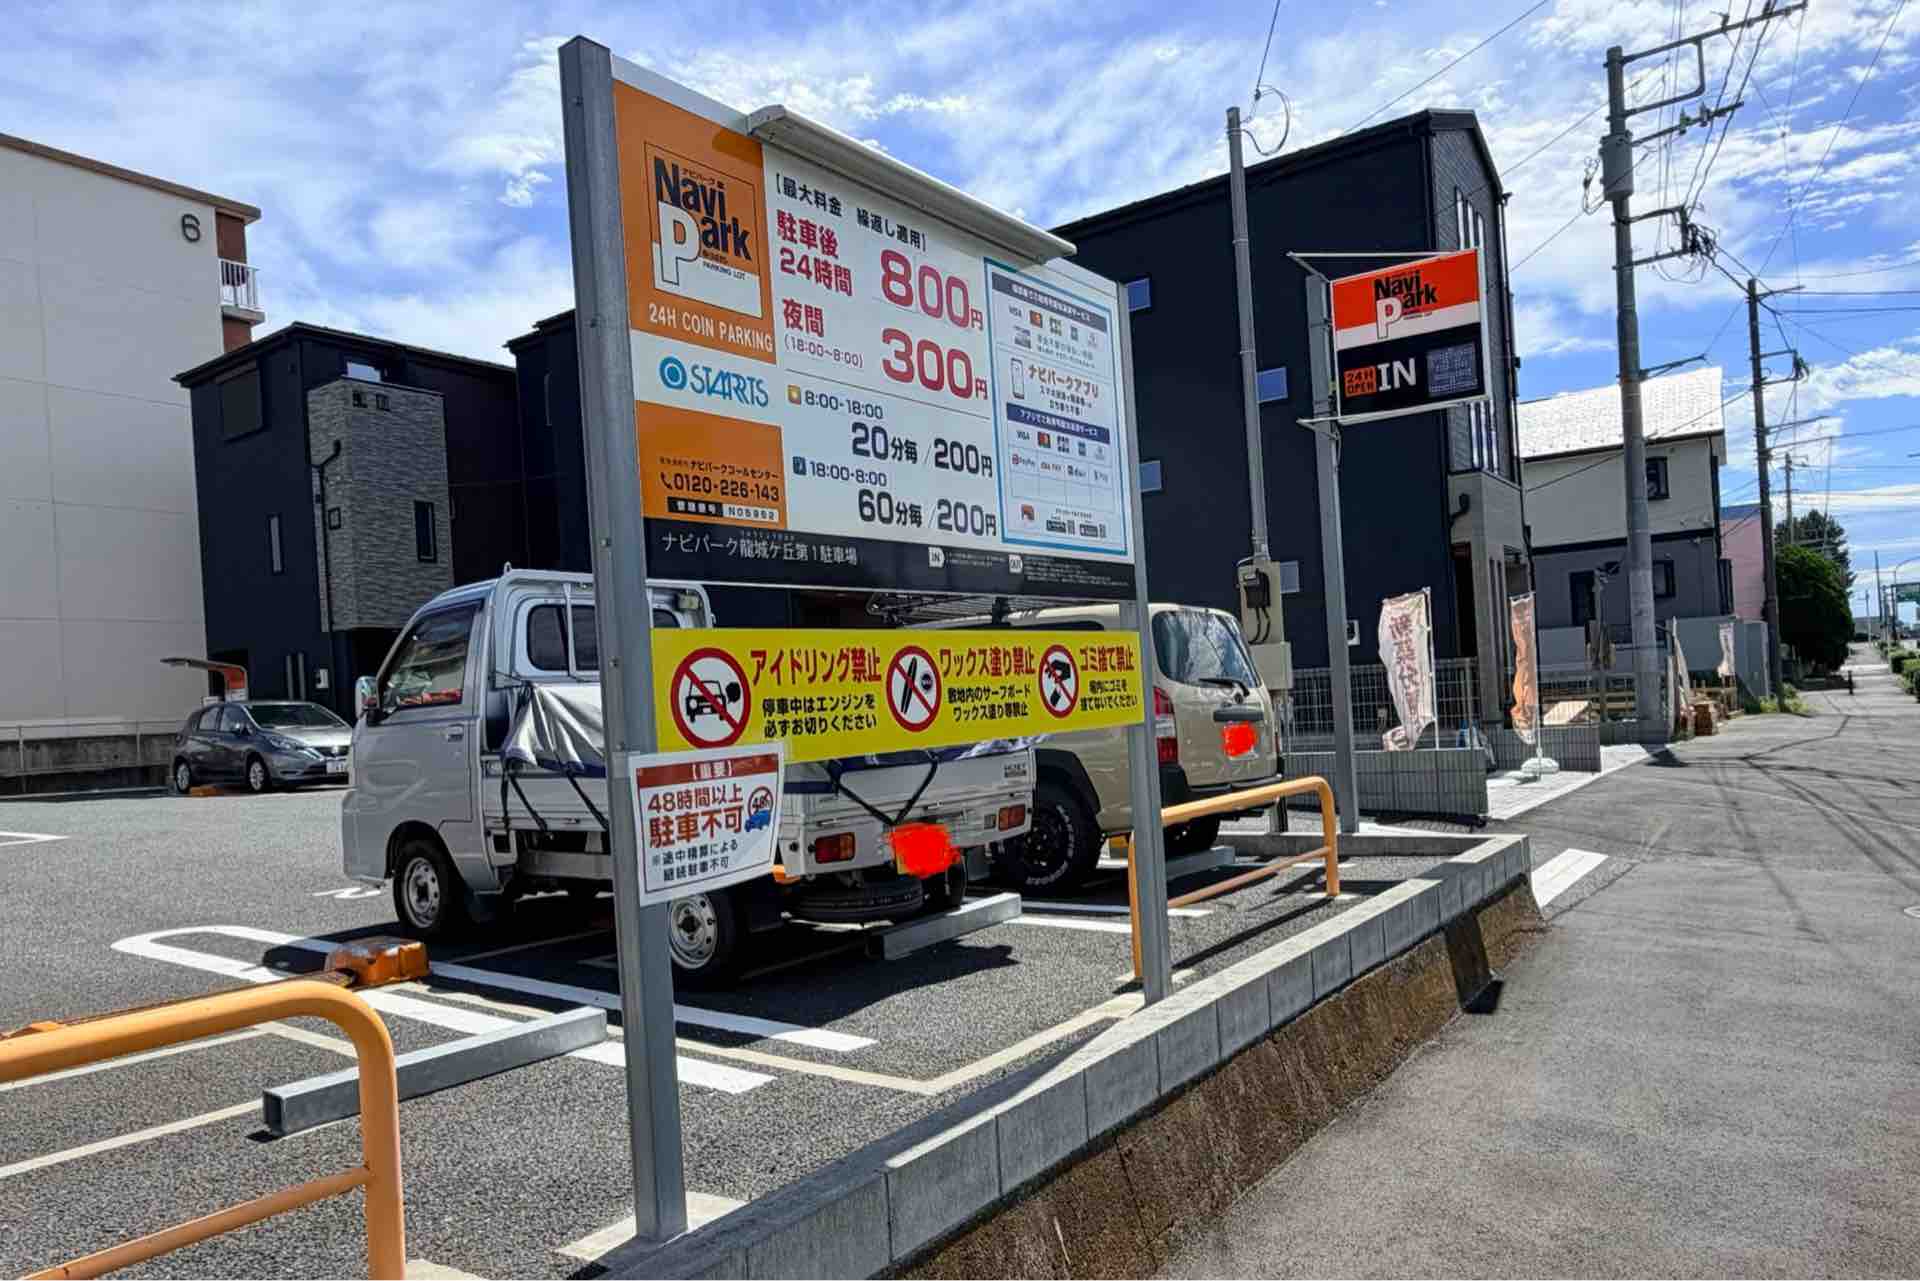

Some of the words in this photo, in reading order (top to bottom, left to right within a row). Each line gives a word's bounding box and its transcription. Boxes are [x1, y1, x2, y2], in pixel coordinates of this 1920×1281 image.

[654, 156, 726, 220] Navi
[181, 213, 201, 242] 6
[658, 200, 752, 286] Park
[776, 209, 839, 259] 駐車後
[780, 247, 852, 296] 24時間
[880, 249, 984, 331] 800円
[1374, 270, 1421, 301] Navi
[649, 302, 677, 328] 24H
[681, 311, 715, 337] COIN
[719, 321, 773, 353] PARKING
[782, 298, 824, 338] 夜間
[1376, 284, 1438, 340] Park
[882, 328, 988, 400] 300円
[1377, 357, 1416, 392] IN
[690, 364, 769, 407] STARTS
[750, 646, 882, 686] アイドリング禁止
[939, 645, 1037, 678] ワックス塗り禁止
[1079, 645, 1135, 673] ゴミ捨て禁止
[762, 693, 876, 718] 停車中はエンジンを
[763, 714, 878, 738] 必ずお切りください
[648, 783, 744, 814] 48時間以上
[650, 805, 744, 849] 駐車不可
